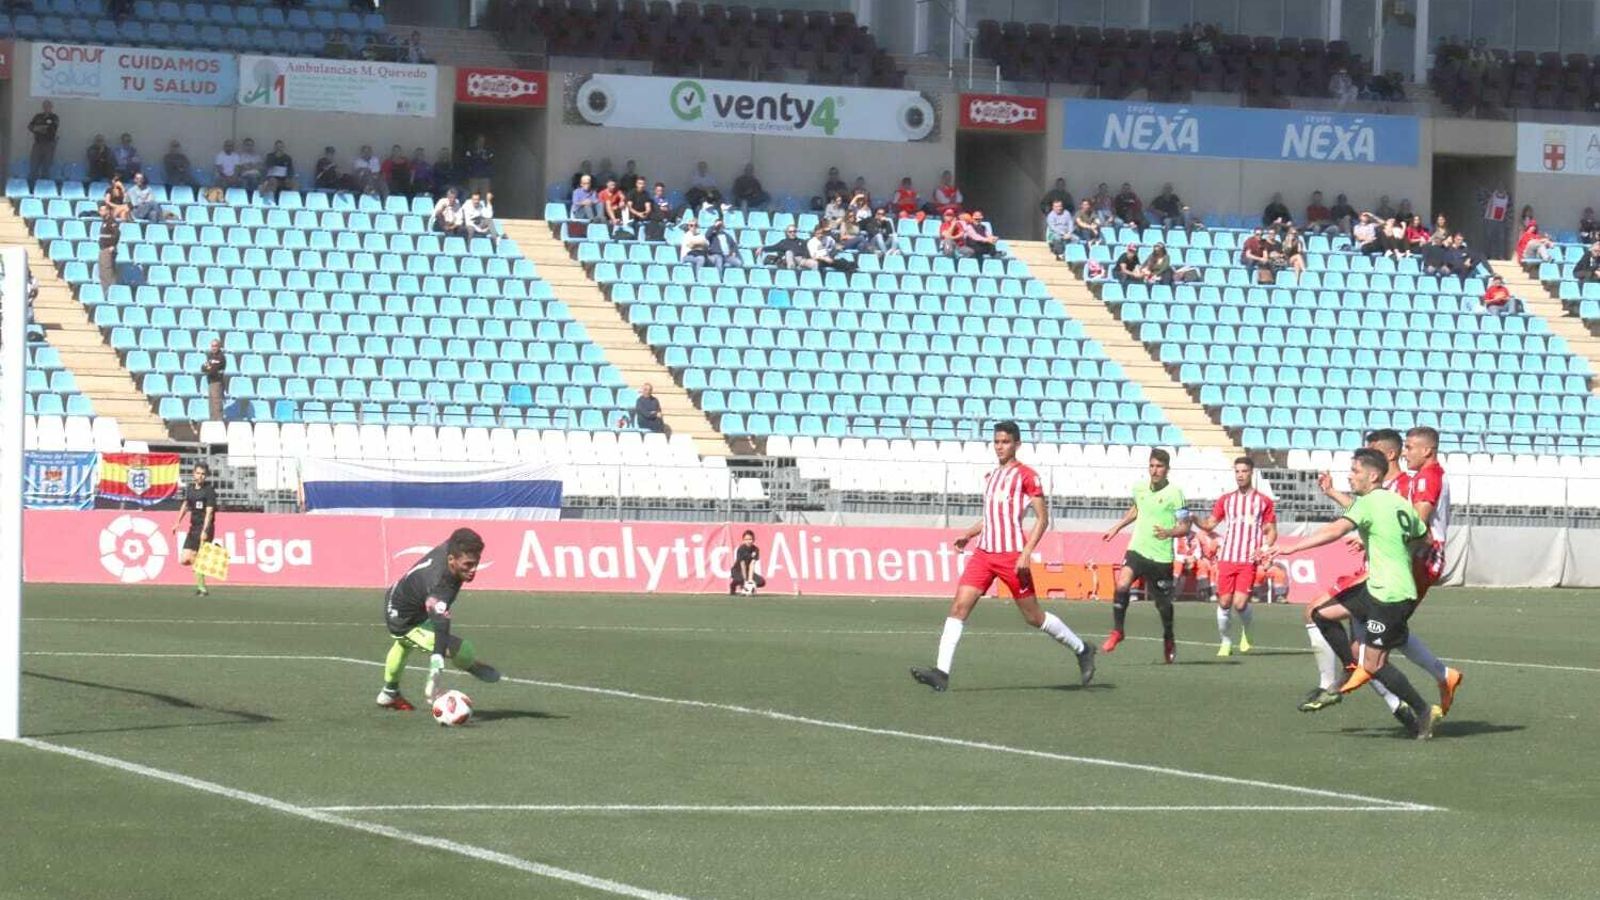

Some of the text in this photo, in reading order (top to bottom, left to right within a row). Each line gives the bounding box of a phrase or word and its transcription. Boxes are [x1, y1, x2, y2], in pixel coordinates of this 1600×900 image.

[118, 54, 221, 73] CUIDAMOS
[286, 62, 428, 79] Ambulancias M. Quevedo
[121, 76, 217, 94] TU SALUD
[713, 93, 840, 136] venty4
[515, 526, 762, 591] Analytic
[1367, 621, 1385, 632] KIA
